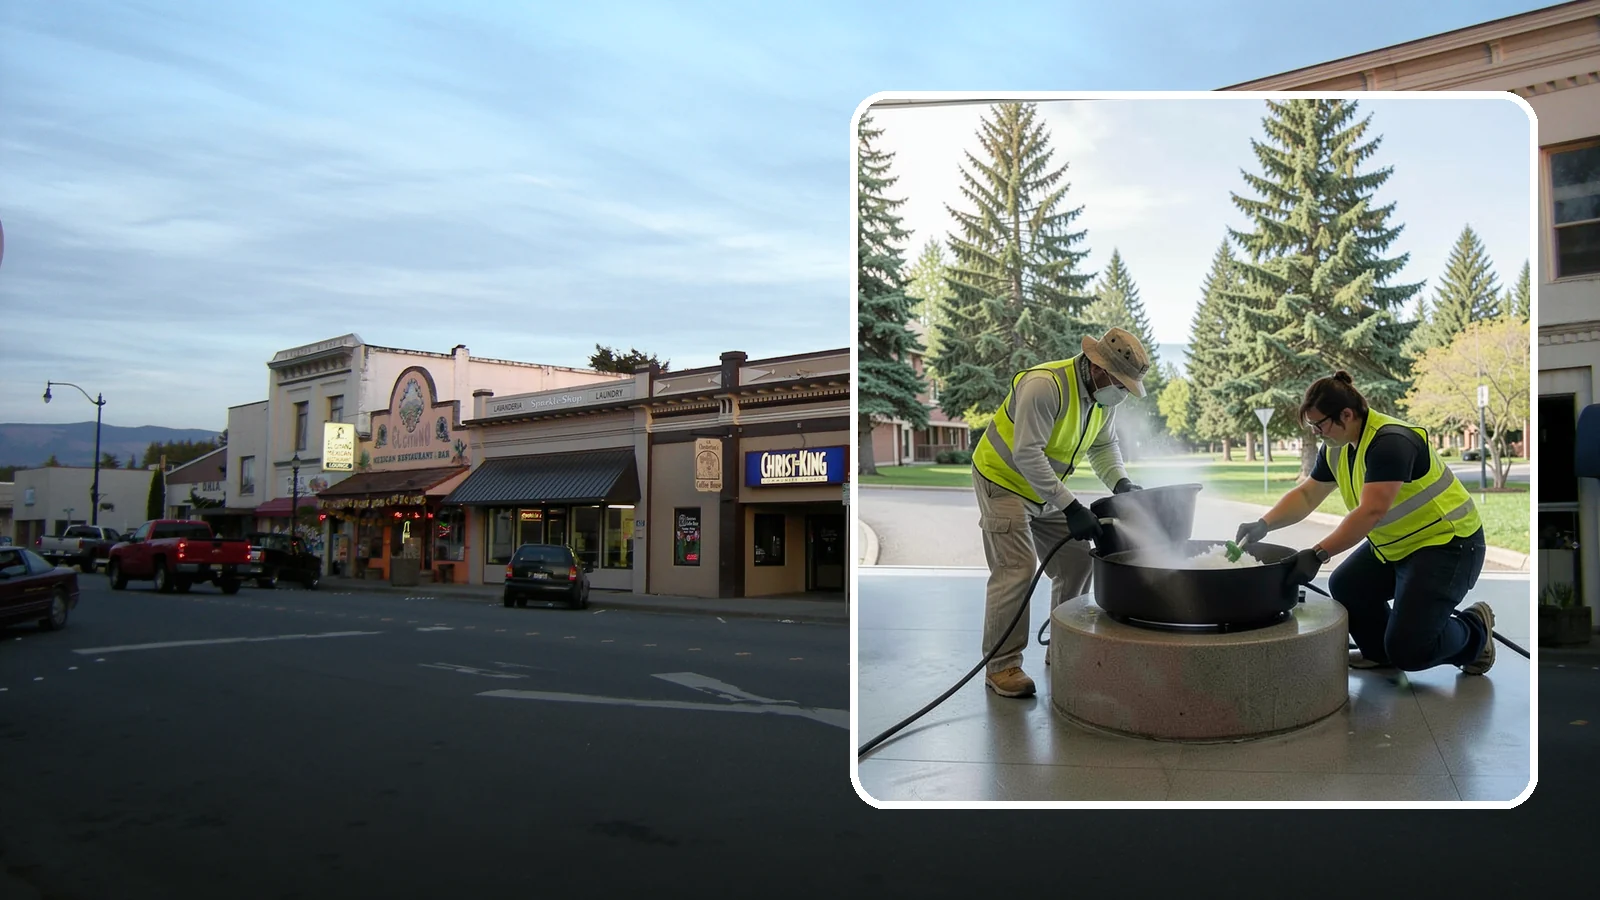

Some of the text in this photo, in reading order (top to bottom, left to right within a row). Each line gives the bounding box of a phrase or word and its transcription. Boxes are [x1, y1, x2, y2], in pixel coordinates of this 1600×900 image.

[561, 394, 582, 406] Shop
[595, 389, 623, 400] LAUNDRY
[493, 402, 522, 413] LAVANDERIA
[373, 454, 396, 464] MEXICAN
[397, 451, 433, 462] RESTAURANT
[438, 450, 450, 459] BAR
[761, 450, 827, 478] CHRIST KING
